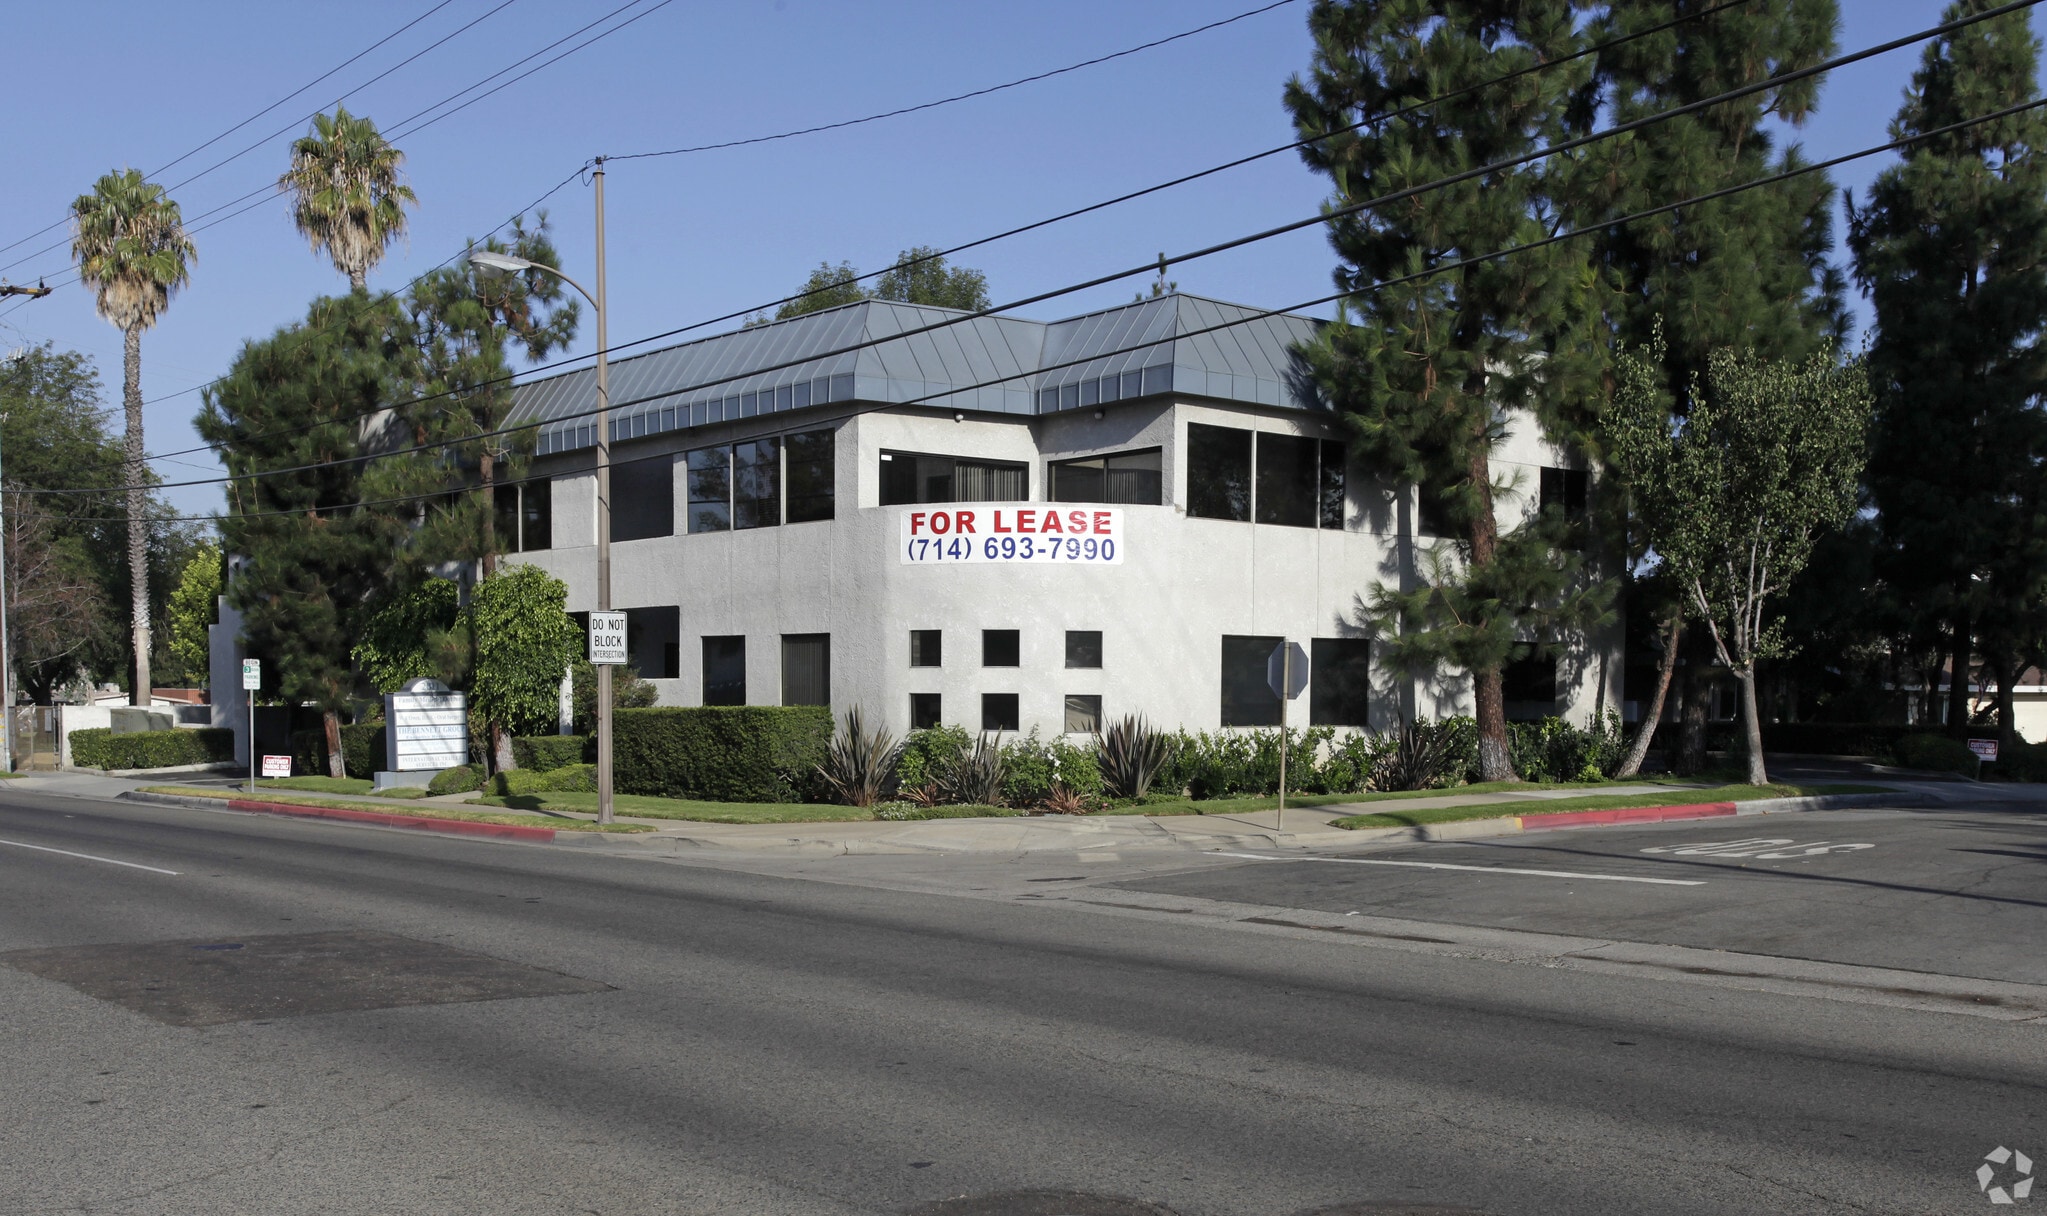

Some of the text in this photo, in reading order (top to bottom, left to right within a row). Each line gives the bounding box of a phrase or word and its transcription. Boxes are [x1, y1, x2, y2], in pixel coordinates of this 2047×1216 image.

[911, 510, 1112, 535] FOR LEASE
[908, 537, 1115, 561] (714) 693-7990
[592, 618, 624, 631] DO NOT
[594, 635, 622, 647] BLOCK
[592, 650, 625, 659] INTERSECTION
[398, 727, 412, 735] THE
[443, 725, 465, 733] GROUP
